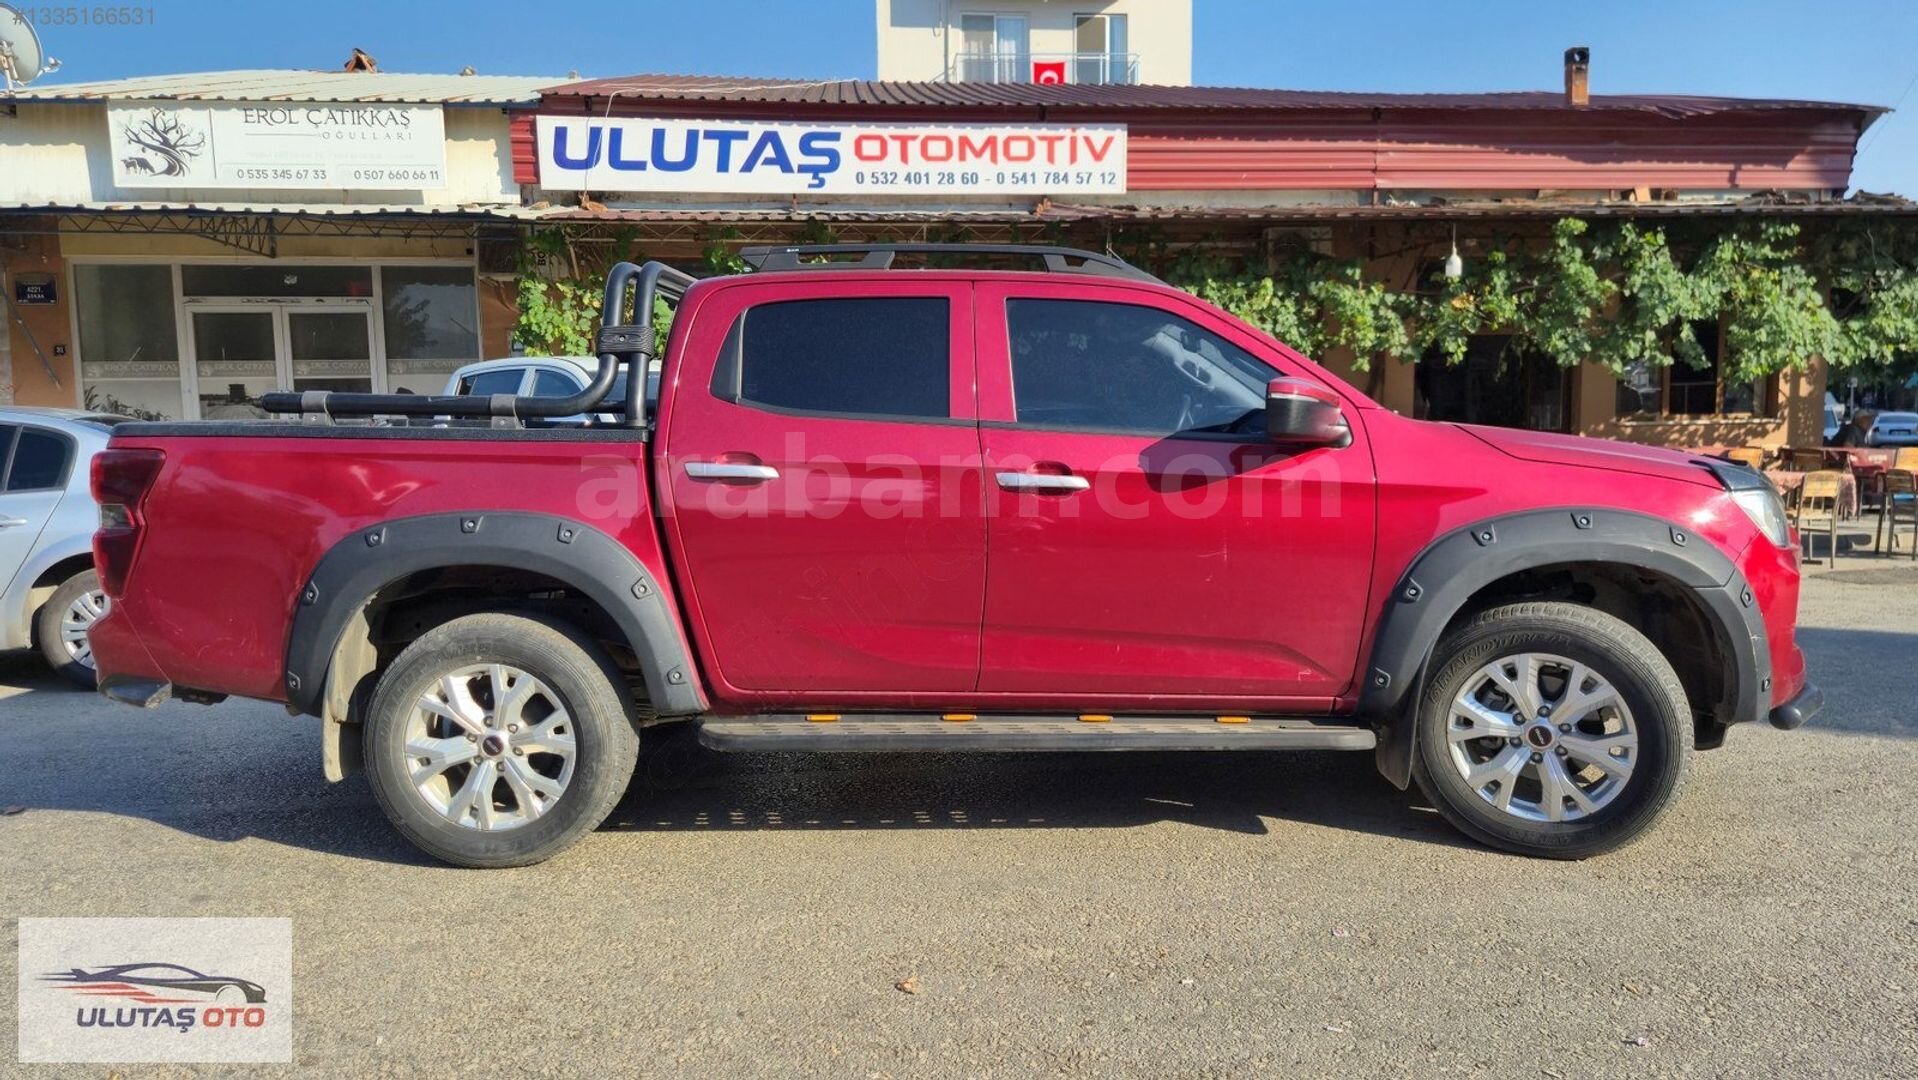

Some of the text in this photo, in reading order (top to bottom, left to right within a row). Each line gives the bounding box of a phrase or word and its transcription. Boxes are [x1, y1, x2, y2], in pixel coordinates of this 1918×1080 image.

[243, 108, 411, 129] EROL ÇATIKKAŞ
[322, 130, 412, 141] OĞULLARI
[553, 126, 1115, 189] ULUTAŞ OTOMOTİV
[236, 169, 327, 180] 0 535 345 67 33
[354, 170, 439, 181] 0 507 660 66 11
[855, 171, 865, 185] 0
[871, 171, 899, 185] 532
[904, 171, 931, 185] 401
[937, 171, 955, 185] 28
[961, 171, 979, 185] 60
[996, 171, 1005, 185] 0
[1011, 171, 1037, 185] 541
[1043, 171, 1070, 185] 784
[1076, 171, 1093, 185] 57
[1100, 171, 1117, 185] 12
